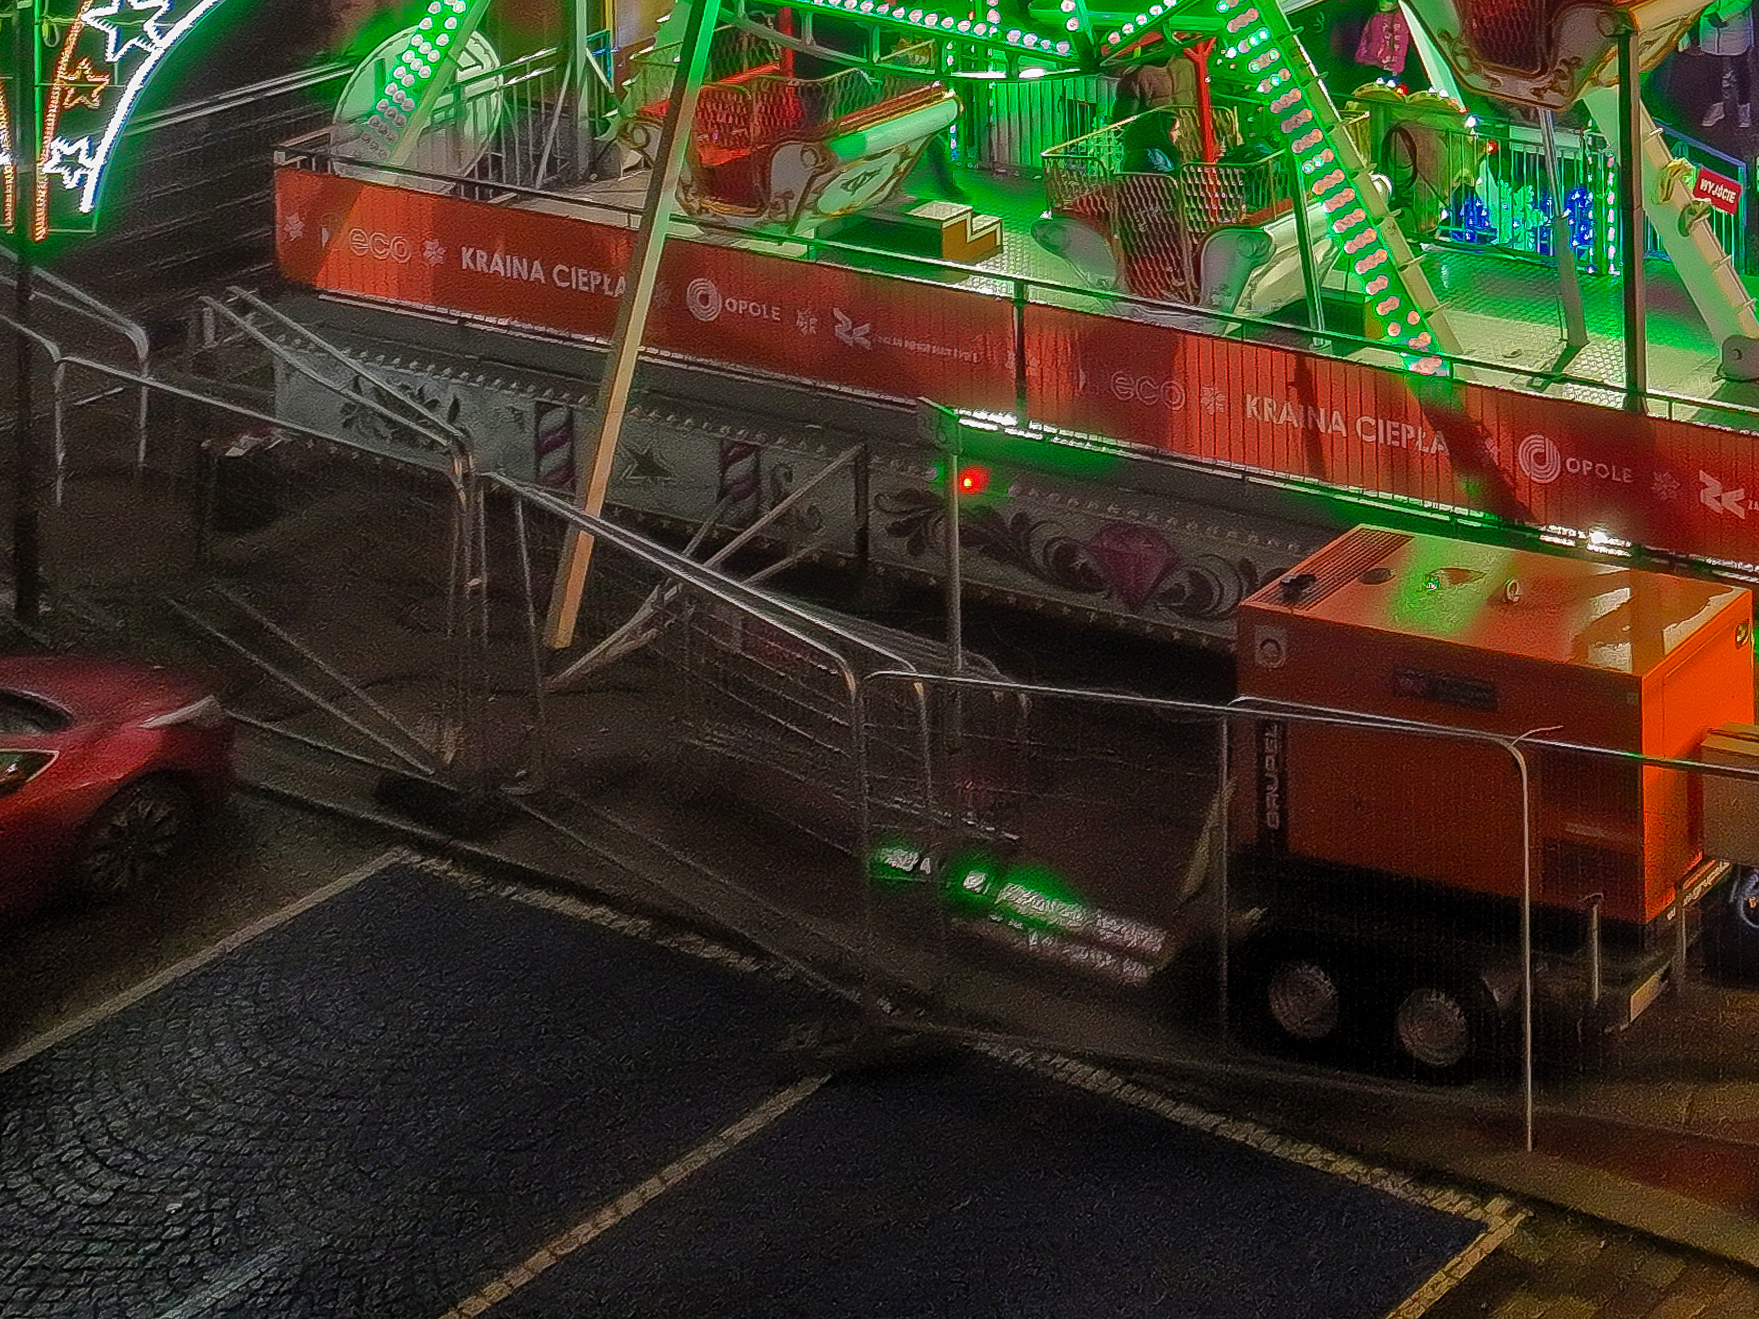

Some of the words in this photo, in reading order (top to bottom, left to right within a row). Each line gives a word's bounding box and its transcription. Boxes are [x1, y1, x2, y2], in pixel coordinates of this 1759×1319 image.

[349, 228, 412, 264] eco
[461, 247, 547, 284] KRAINA
[552, 264, 627, 297] CIEPŁA
[724, 297, 781, 321] OPOLE
[1110, 370, 1186, 411] eco
[1246, 393, 1348, 437] KRAINA
[1356, 415, 1449, 455] CIEPŁA
[1565, 457, 1634, 483] OPOLE
